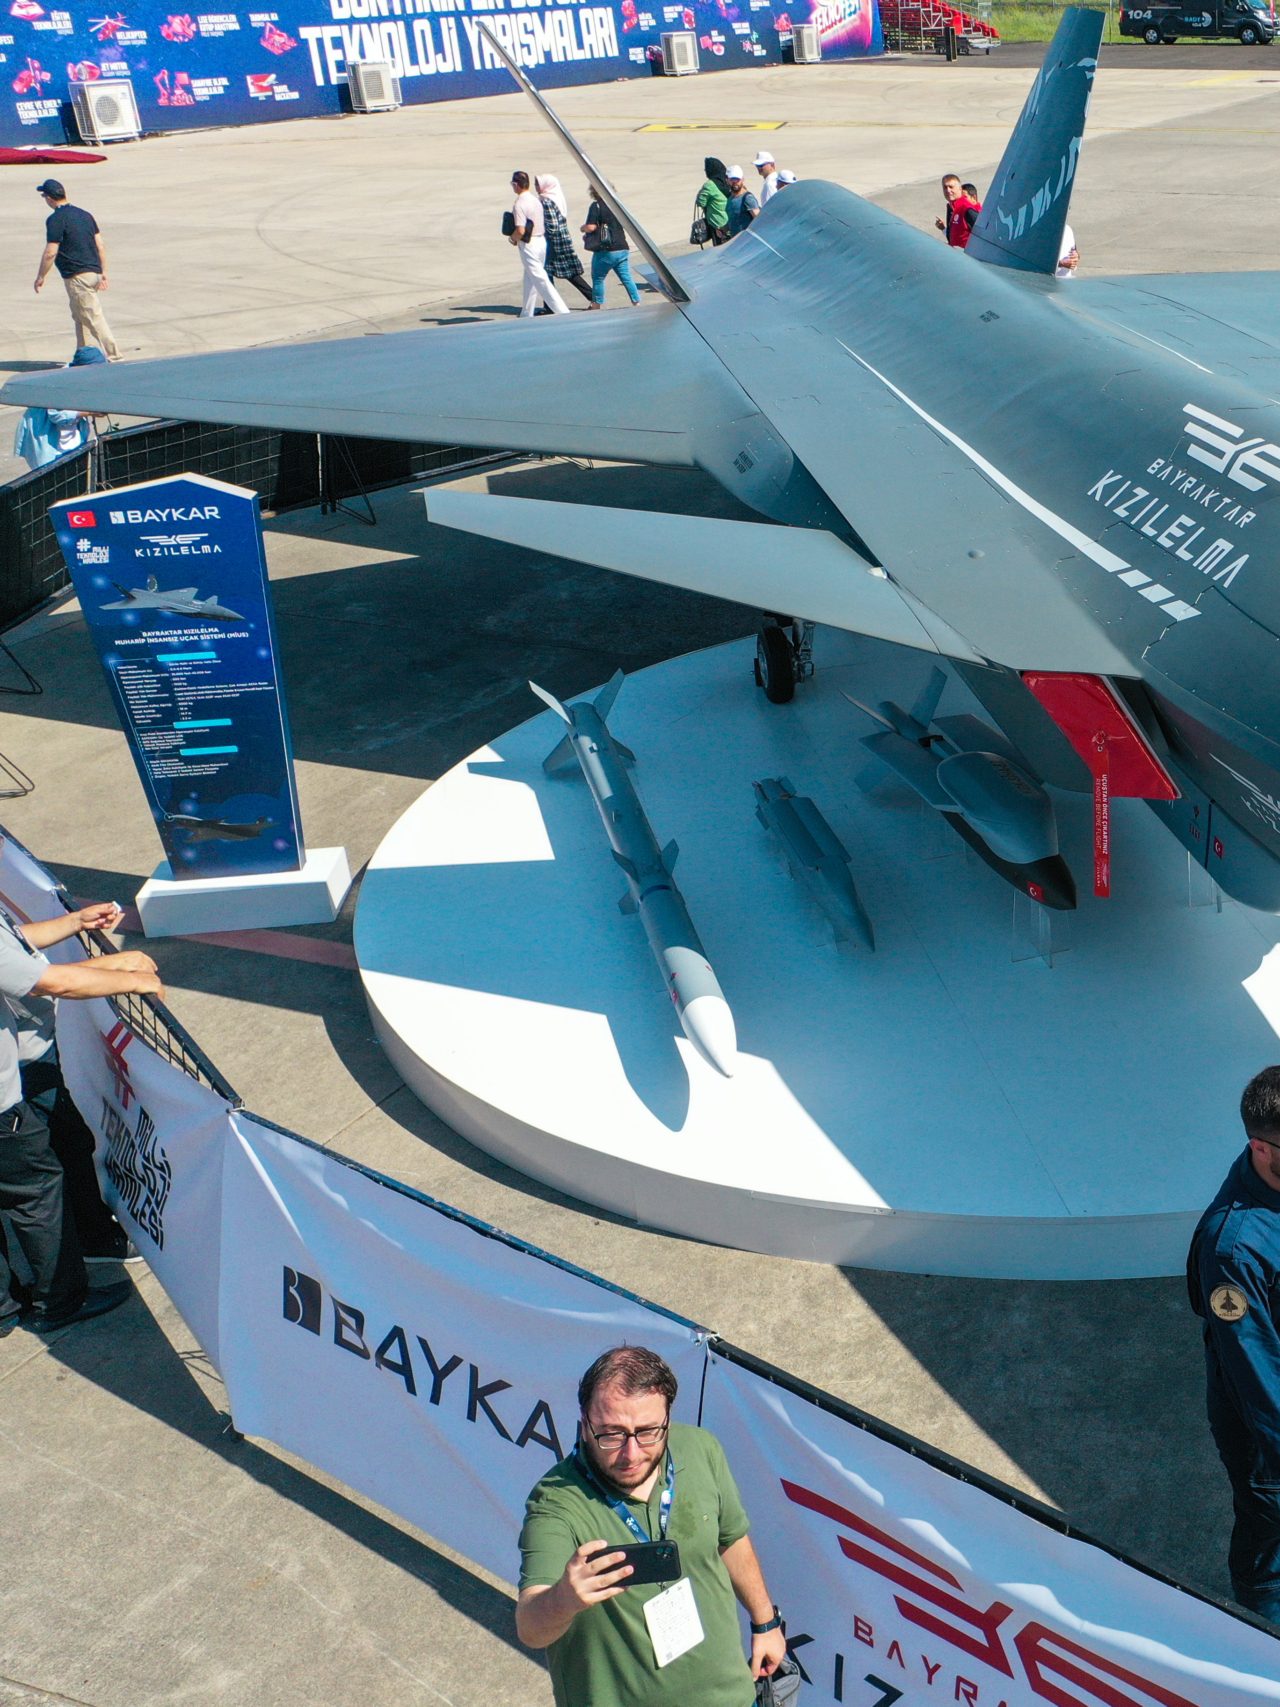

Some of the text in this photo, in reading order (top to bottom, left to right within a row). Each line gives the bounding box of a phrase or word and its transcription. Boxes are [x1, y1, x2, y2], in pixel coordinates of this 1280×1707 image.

[299, 19, 464, 86] TEKNOLOJİ
[126, 506, 221, 524] BAYKAR
[1146, 457, 1257, 529] BAYRAKTAR
[134, 544, 222, 558] KIZILELMA
[1087, 469, 1250, 589] KIZILELMA
[142, 629, 182, 638] BAYRAKTAR
[330, 1293, 581, 1462] BAYKA
